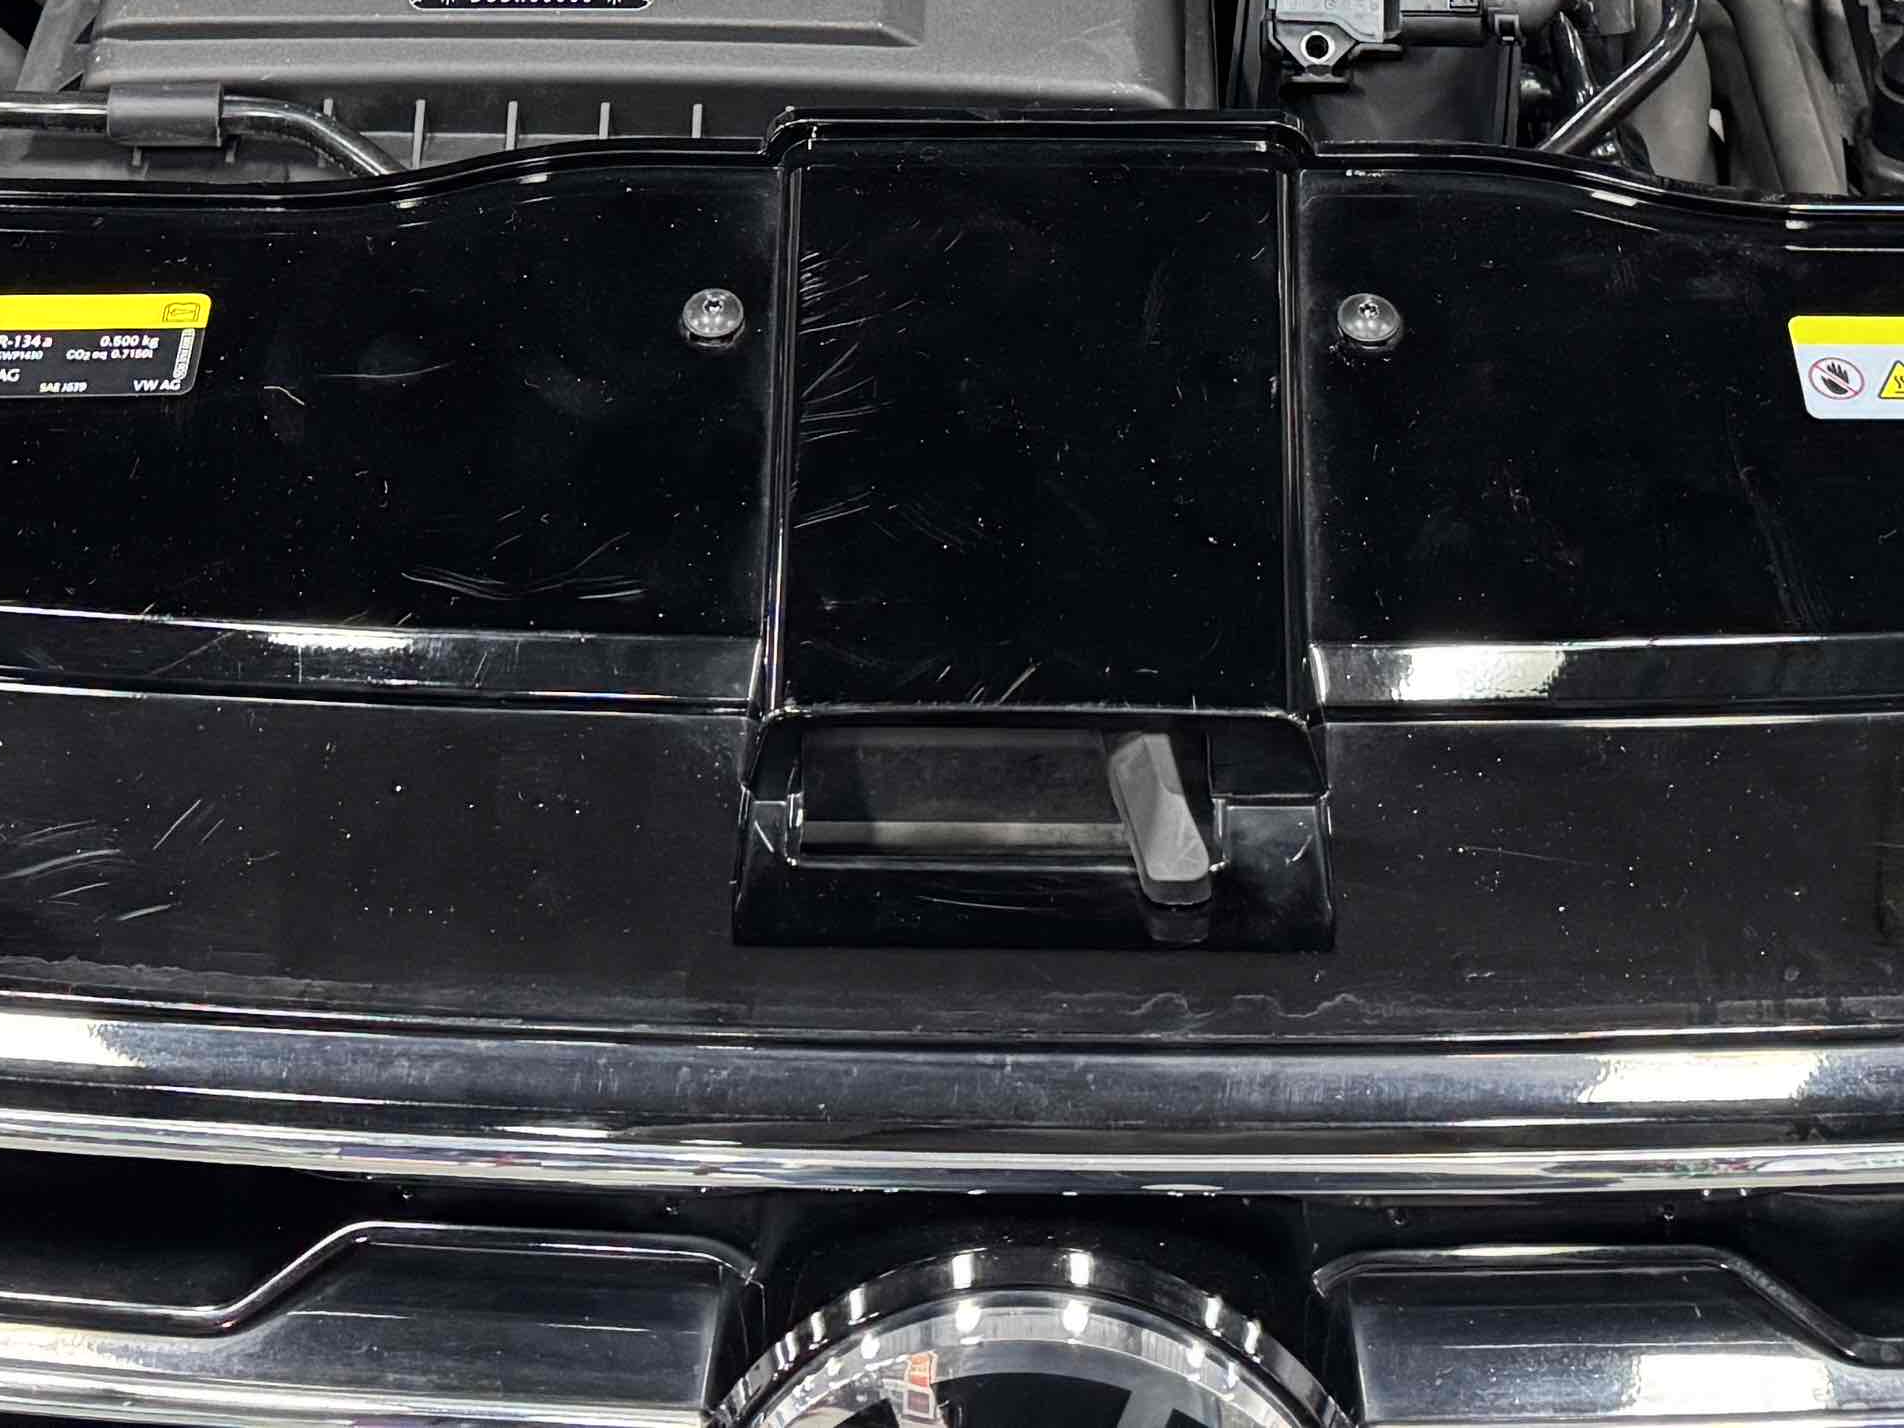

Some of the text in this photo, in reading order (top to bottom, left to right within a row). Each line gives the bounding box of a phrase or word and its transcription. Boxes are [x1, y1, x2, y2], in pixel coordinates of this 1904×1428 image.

[99, 335, 139, 348] 0.500
[141, 334, 160, 349] kg
[132, 380, 159, 392] VW
[159, 379, 182, 391] AG
